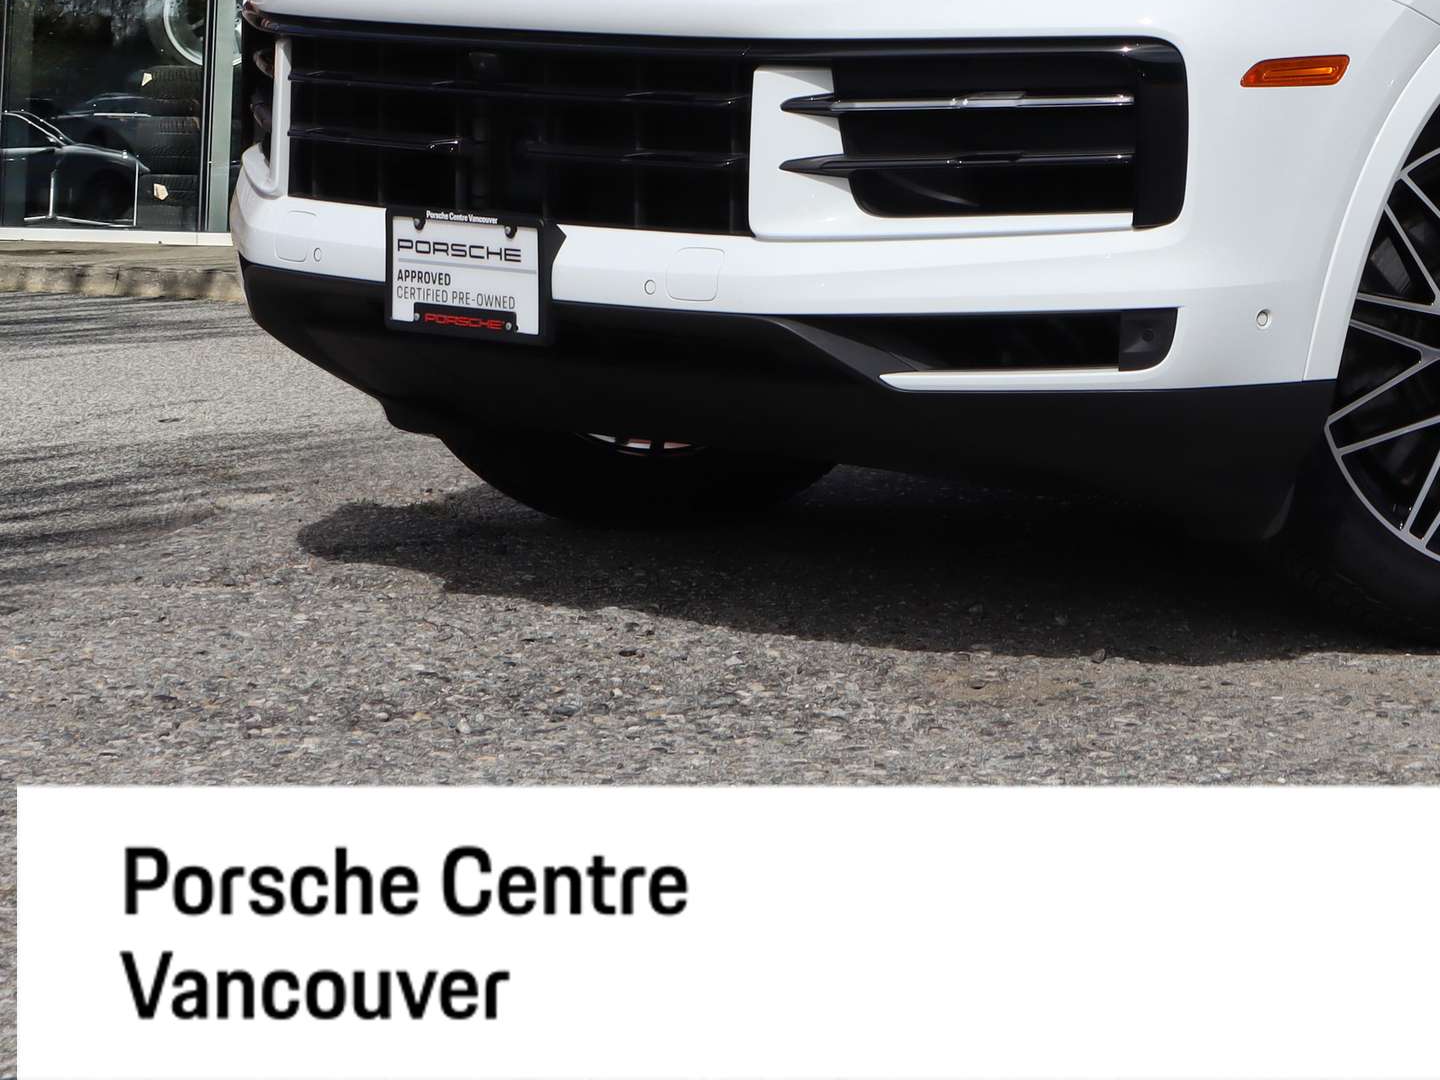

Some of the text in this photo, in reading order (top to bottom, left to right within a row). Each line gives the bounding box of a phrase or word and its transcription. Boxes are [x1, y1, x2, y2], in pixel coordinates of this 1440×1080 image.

[426, 210, 498, 224] Porsche Centre Vancouver
[397, 239, 522, 262] PORSCHE
[397, 269, 451, 286] APPROVED
[397, 286, 516, 310] CERTIFIED PRE-OWNED
[424, 312, 504, 329] PORSCHE
